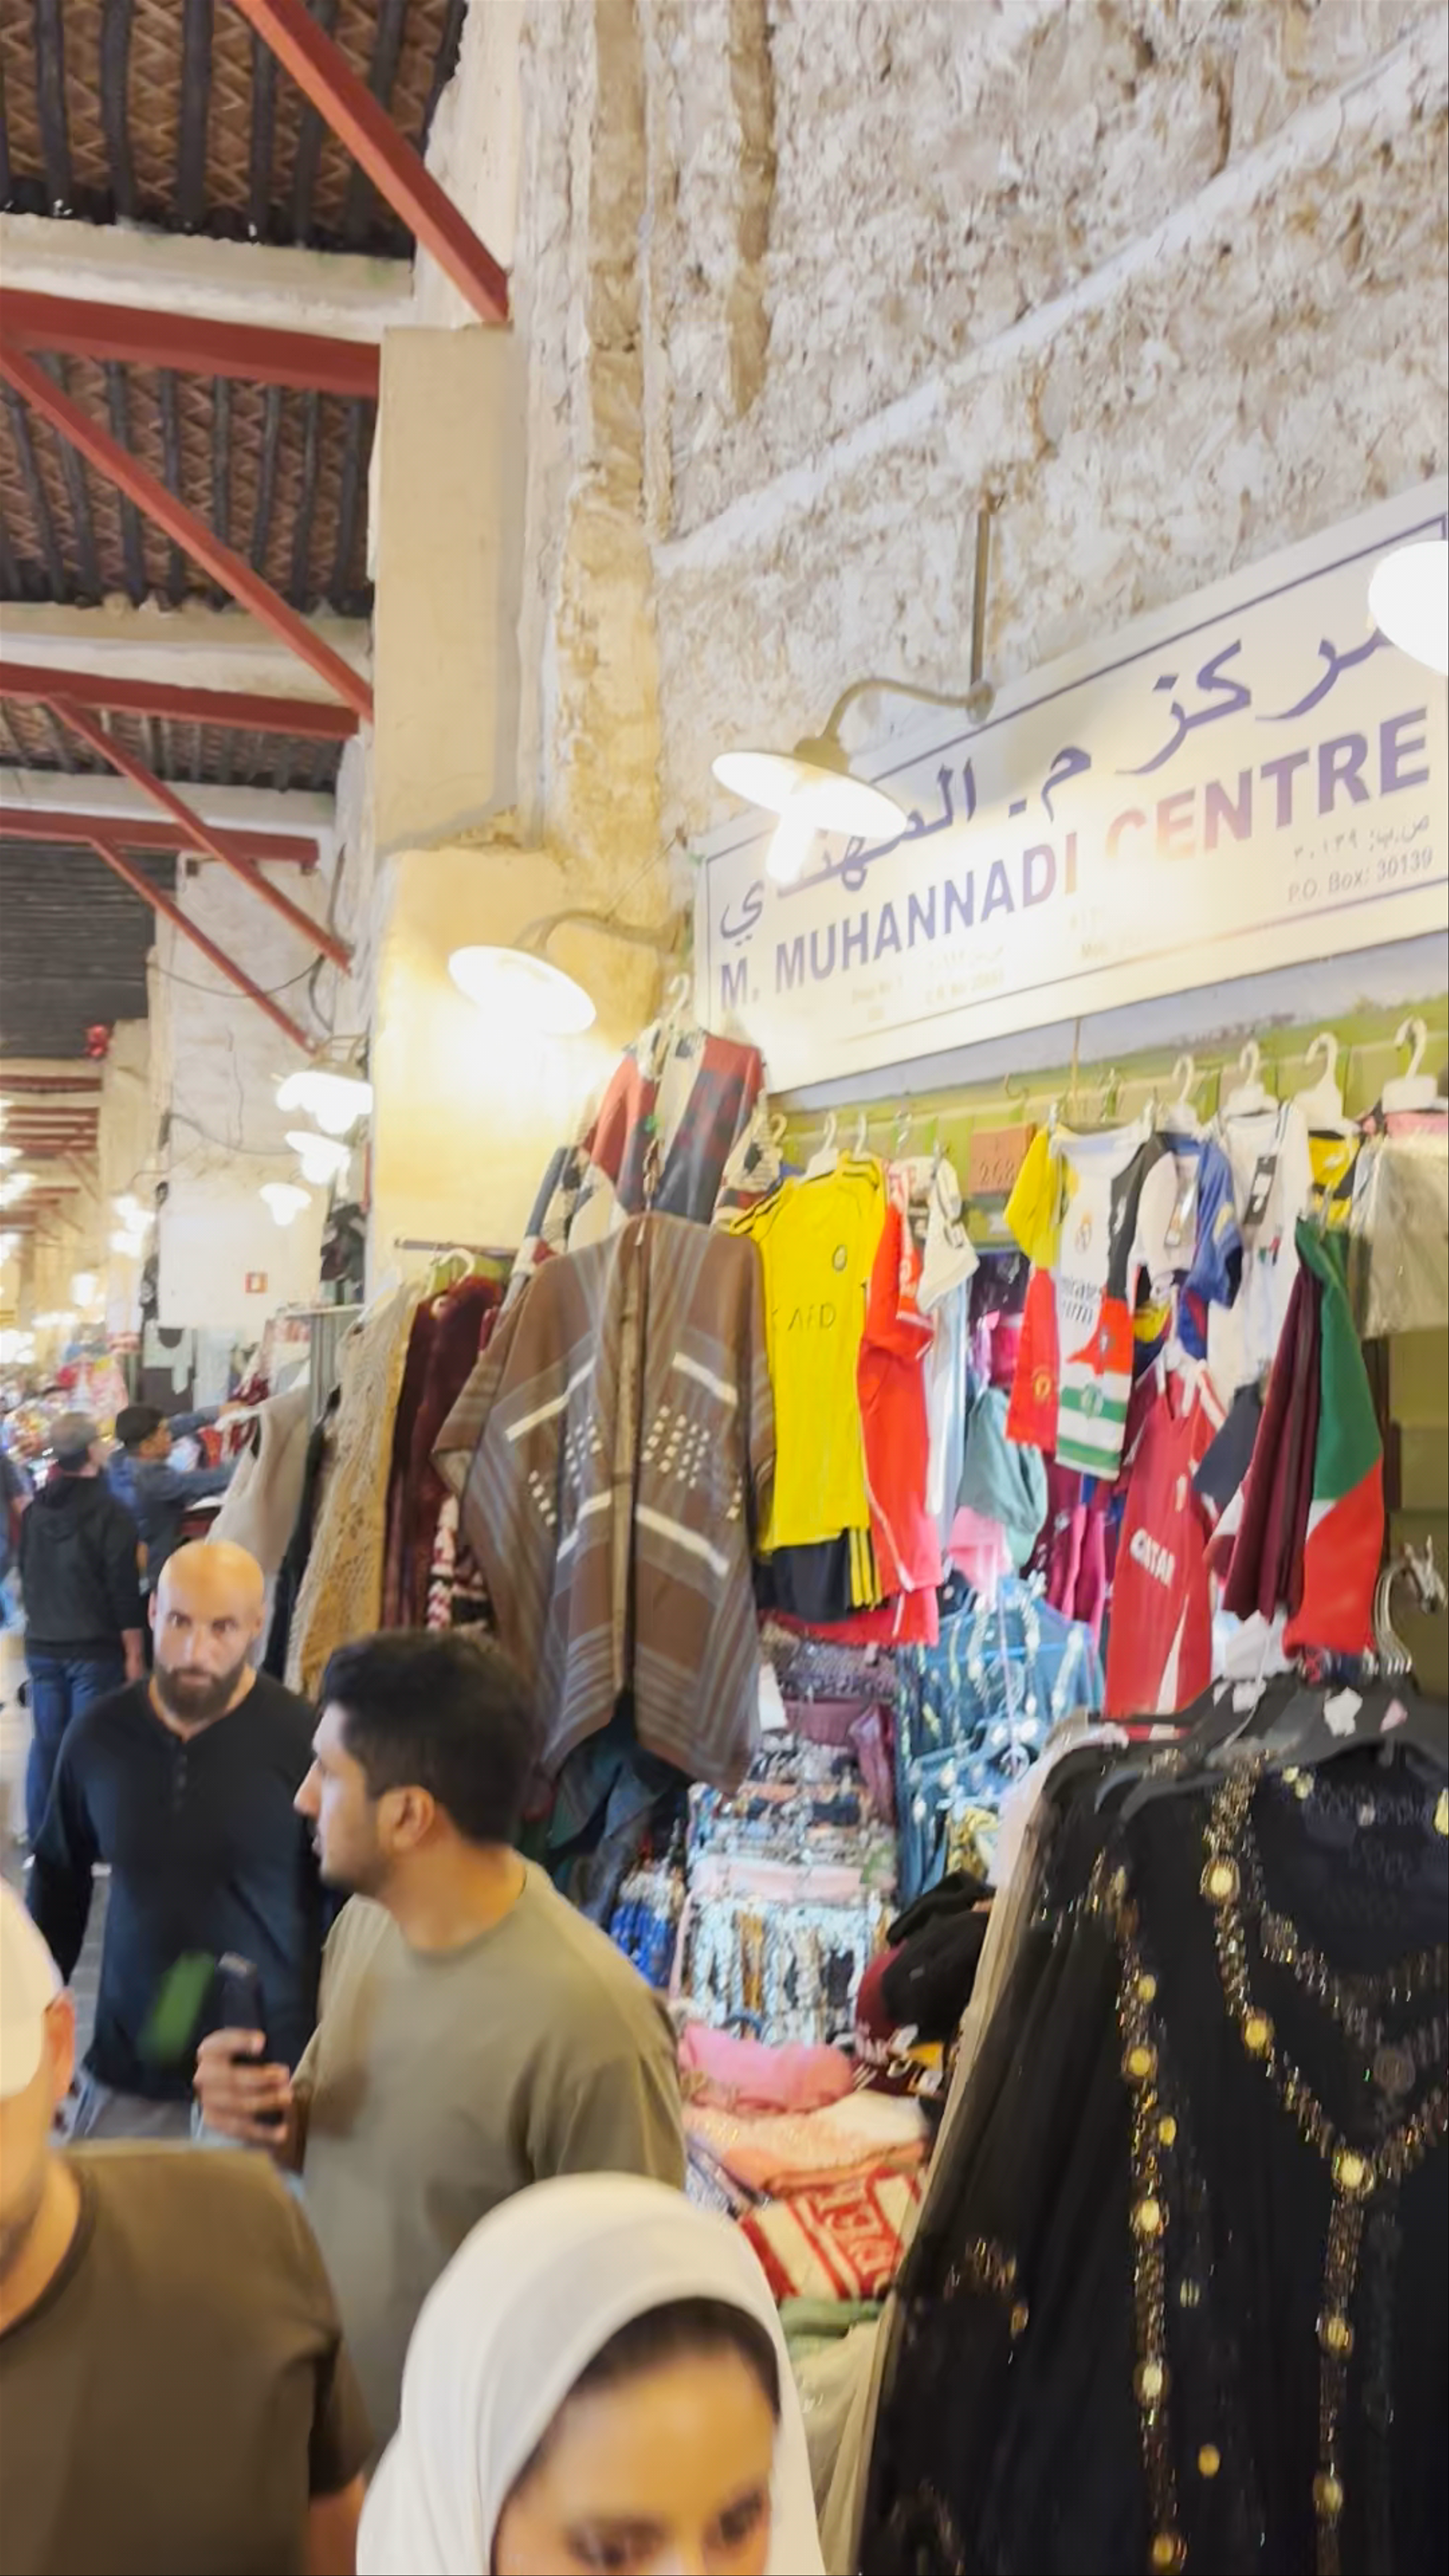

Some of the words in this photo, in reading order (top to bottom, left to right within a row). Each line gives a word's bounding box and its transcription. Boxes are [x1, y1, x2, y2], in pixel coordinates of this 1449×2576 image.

[1114, 626, 1394, 776] ركز
[720, 957, 759, 1012] M.
[776, 830, 1078, 994] MUHANNADI
[1104, 704, 1430, 861] CENTRE
